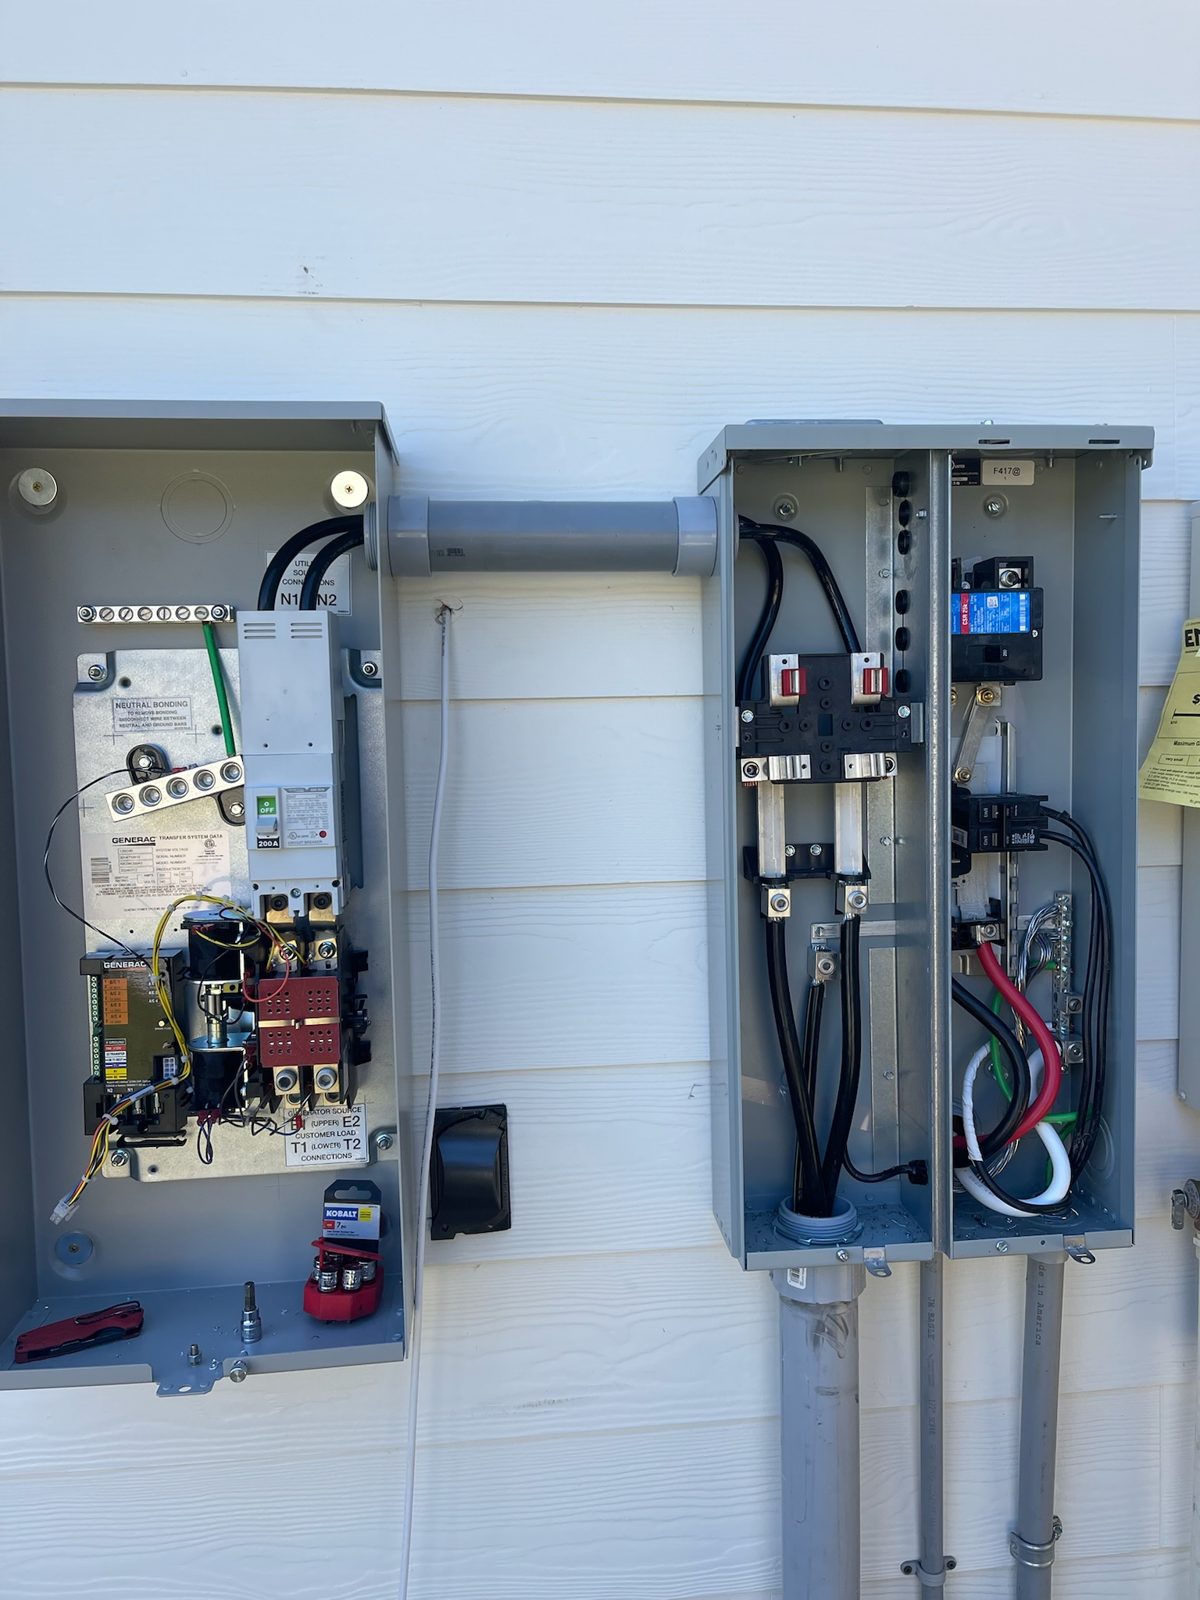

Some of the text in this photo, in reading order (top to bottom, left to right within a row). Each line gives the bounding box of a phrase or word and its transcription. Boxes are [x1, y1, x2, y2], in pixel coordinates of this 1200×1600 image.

[282, 578, 335, 586] CONNONS
[281, 593, 337, 606] N1 N2
[112, 836, 156, 844] GENERAC
[288, 1108, 330, 1117] GERATOR
[311, 1119, 340, 1127] (UPPER)
[343, 1115, 361, 1128] E2
[295, 1129, 356, 1139] CUSTOMER LOAD
[291, 1138, 361, 1153] T1 (LOWER) T2
[301, 1153, 353, 1162] CONNECTIONS
[326, 1210, 358, 1218] KOBALT
[1035, 1302, 1044, 1346] America
